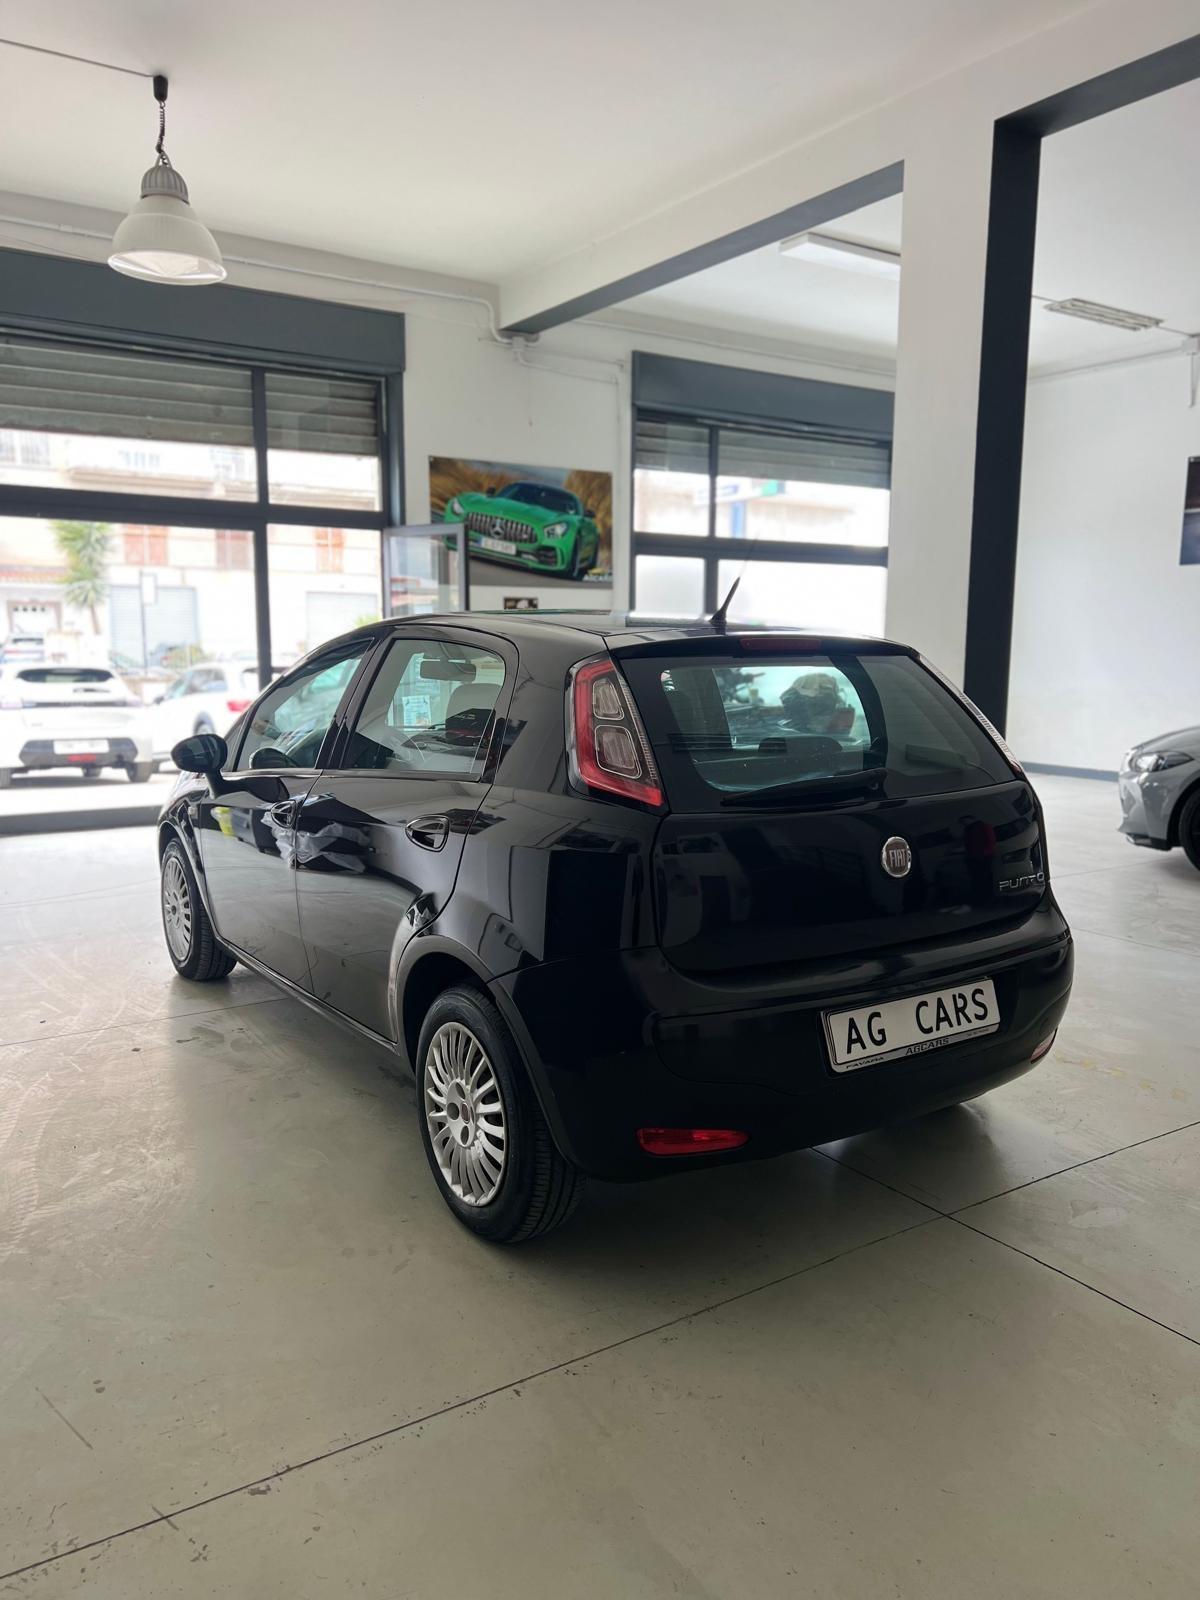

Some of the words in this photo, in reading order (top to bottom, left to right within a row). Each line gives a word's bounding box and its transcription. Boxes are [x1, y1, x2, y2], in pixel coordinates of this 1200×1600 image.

[889, 848, 906, 867] FIAT
[846, 1012, 887, 1054] AG
[916, 988, 988, 1033] CARS
[905, 1038, 950, 1055] AGCARS
